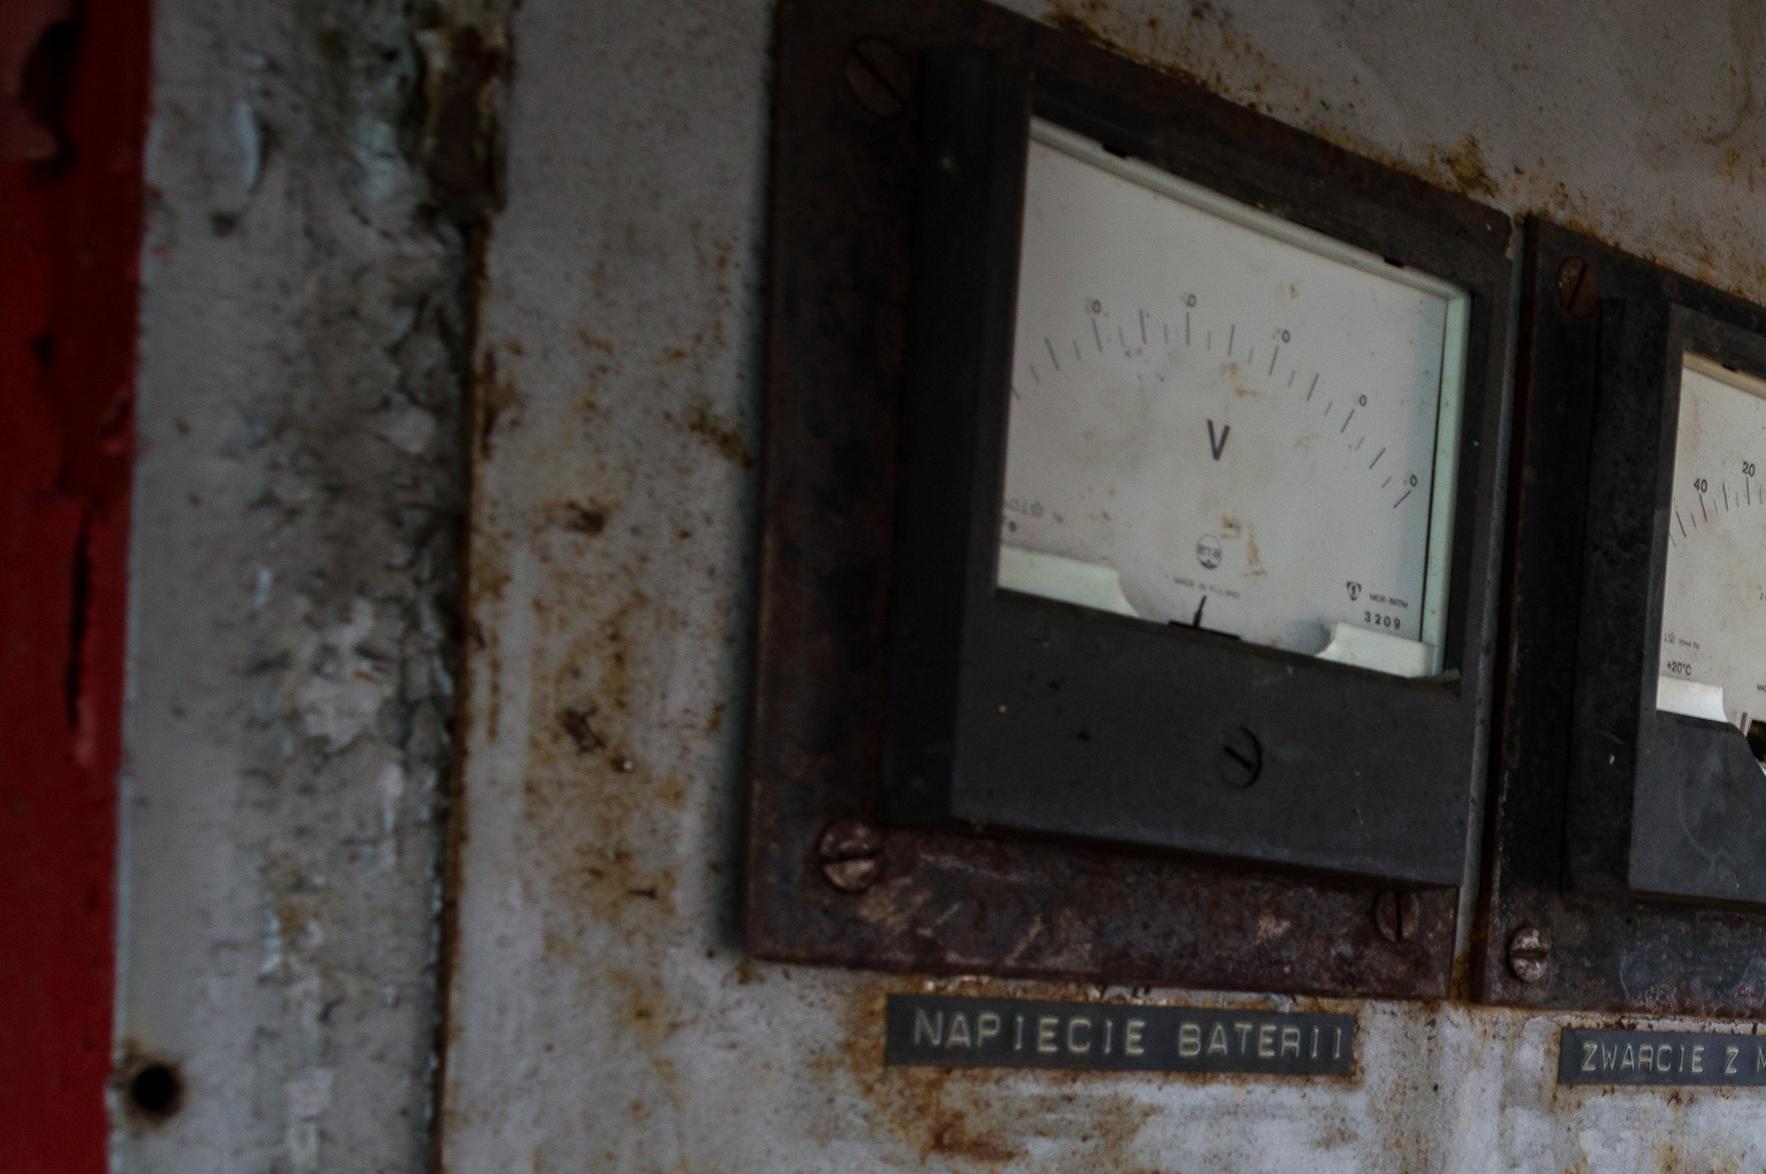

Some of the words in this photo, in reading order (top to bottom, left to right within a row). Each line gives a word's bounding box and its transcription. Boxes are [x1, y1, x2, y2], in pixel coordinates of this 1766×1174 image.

[1207, 418, 1231, 461] V
[1742, 461, 1756, 477] 20
[1694, 478, 1708, 493] 40
[1364, 610, 1402, 630] 3209
[913, 1007, 1146, 1057] NAPIECIE
[1177, 1023, 1342, 1060] BATERII
[1580, 1041, 1706, 1074] ZWARCIE
[1724, 1046, 1740, 1075] Z
